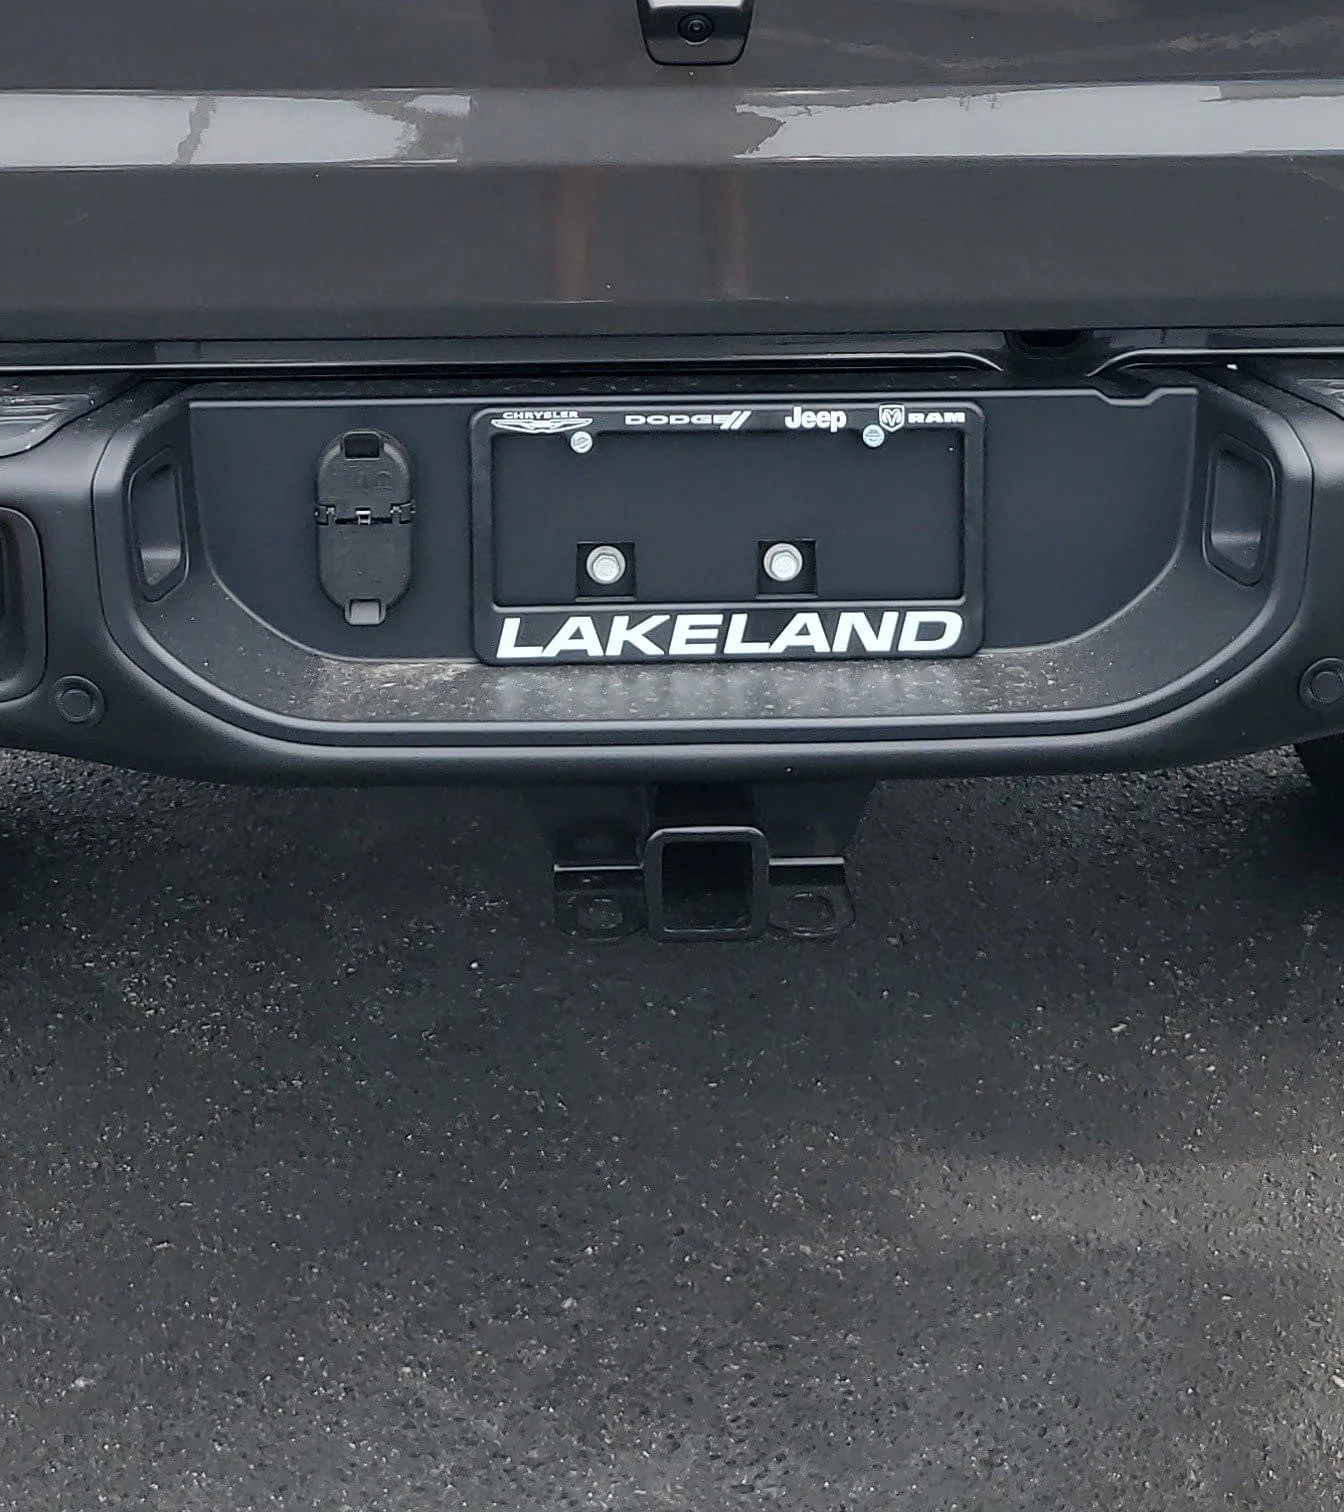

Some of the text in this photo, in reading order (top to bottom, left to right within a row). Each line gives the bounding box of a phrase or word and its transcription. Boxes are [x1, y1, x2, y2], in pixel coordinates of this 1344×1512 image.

[502, 411, 579, 419] CHRYSLER
[625, 414, 732, 425] DODGE
[785, 406, 846, 432] Jeep
[908, 411, 965, 423] RAM
[496, 610, 962, 658] LAKELAND
